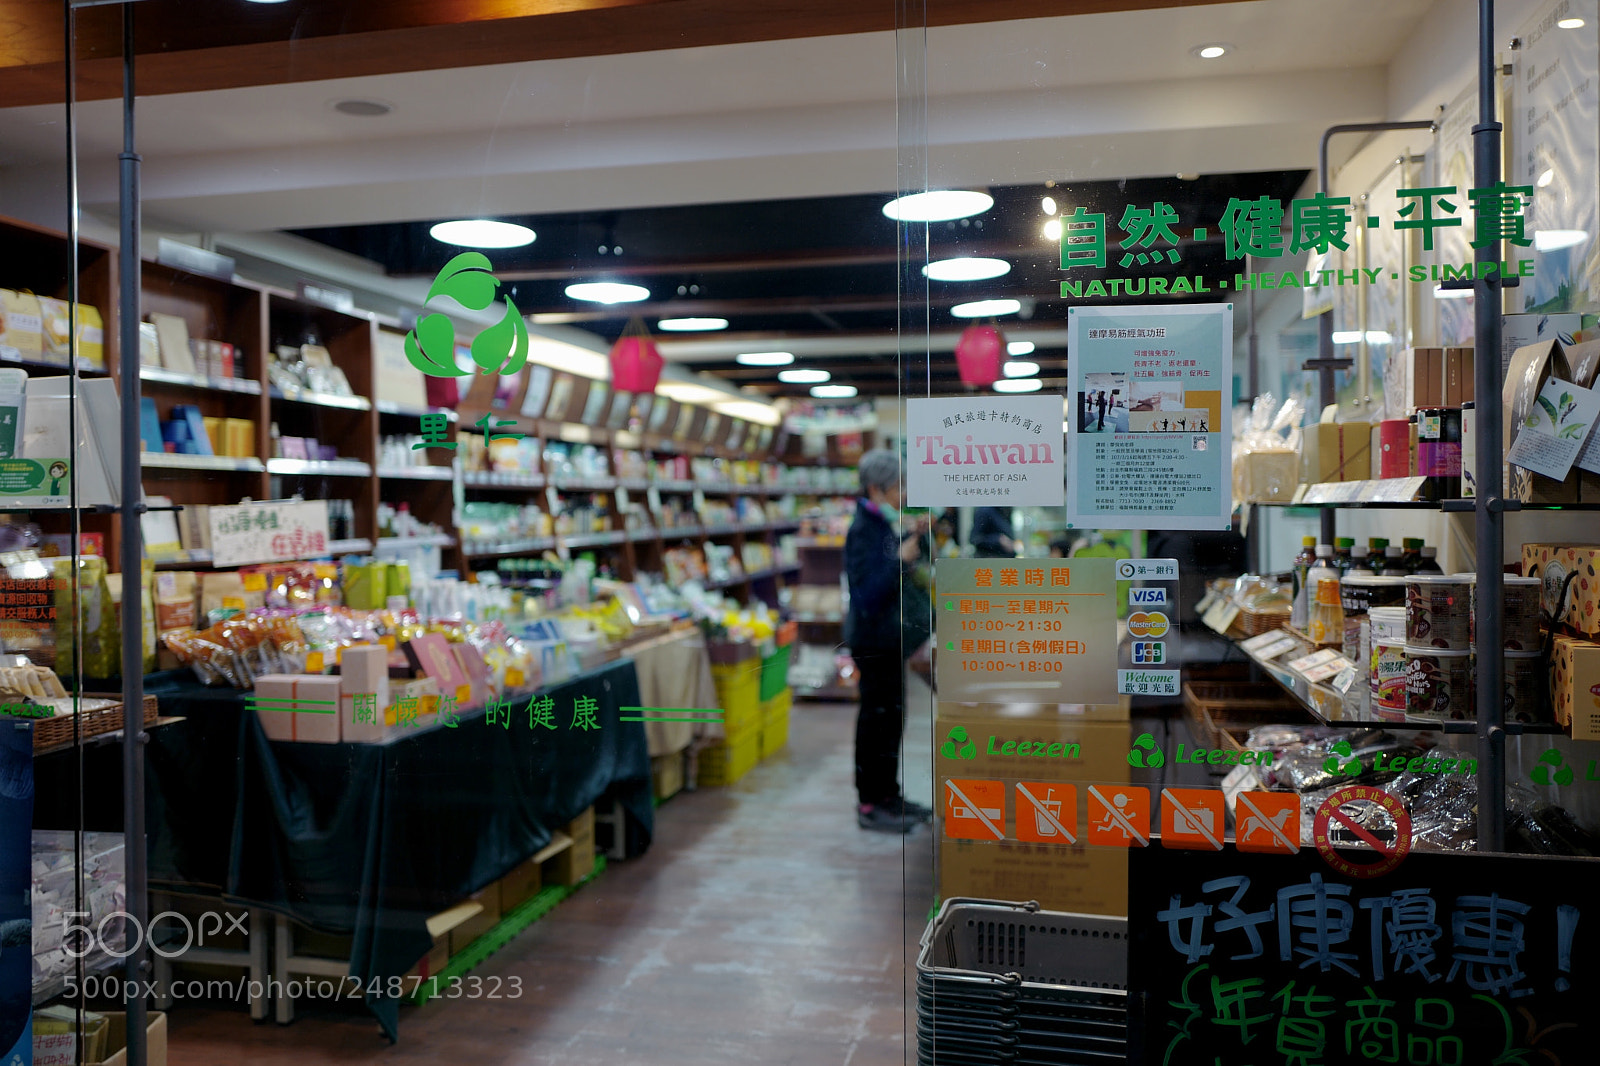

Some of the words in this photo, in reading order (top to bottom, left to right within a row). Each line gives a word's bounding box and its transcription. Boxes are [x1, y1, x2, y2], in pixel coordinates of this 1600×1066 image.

[1060, 274, 1210, 299] NATURAL
[1234, 266, 1382, 292] HEALTHY
[1408, 259, 1535, 283] SIMPLE
[411, 412, 525, 450] 里仁
[942, 409, 1043, 435] 國民旅遊卡特約商店
[916, 435, 1054, 465] Taiwan
[943, 474, 960, 482] THE
[962, 474, 991, 482] HEART
[993, 473, 1005, 481] OF
[1007, 473, 1028, 481] ASIA
[974, 567, 1071, 588] 營業時間
[1137, 566, 1175, 575] 第一銀行
[1132, 590, 1165, 602] VISA
[959, 599, 1070, 615] 星期一至星期六
[1129, 620, 1166, 629] MasterCard
[960, 639, 1087, 655] 星期日(含例假日)
[1125, 671, 1174, 684] Welcome
[1124, 683, 1175, 694] 歡迎光臨
[351, 692, 602, 731] 關懷您的健康
[986, 735, 1081, 759] Leezen
[1175, 743, 1274, 767] Leezen
[1373, 751, 1478, 776] Leezen
